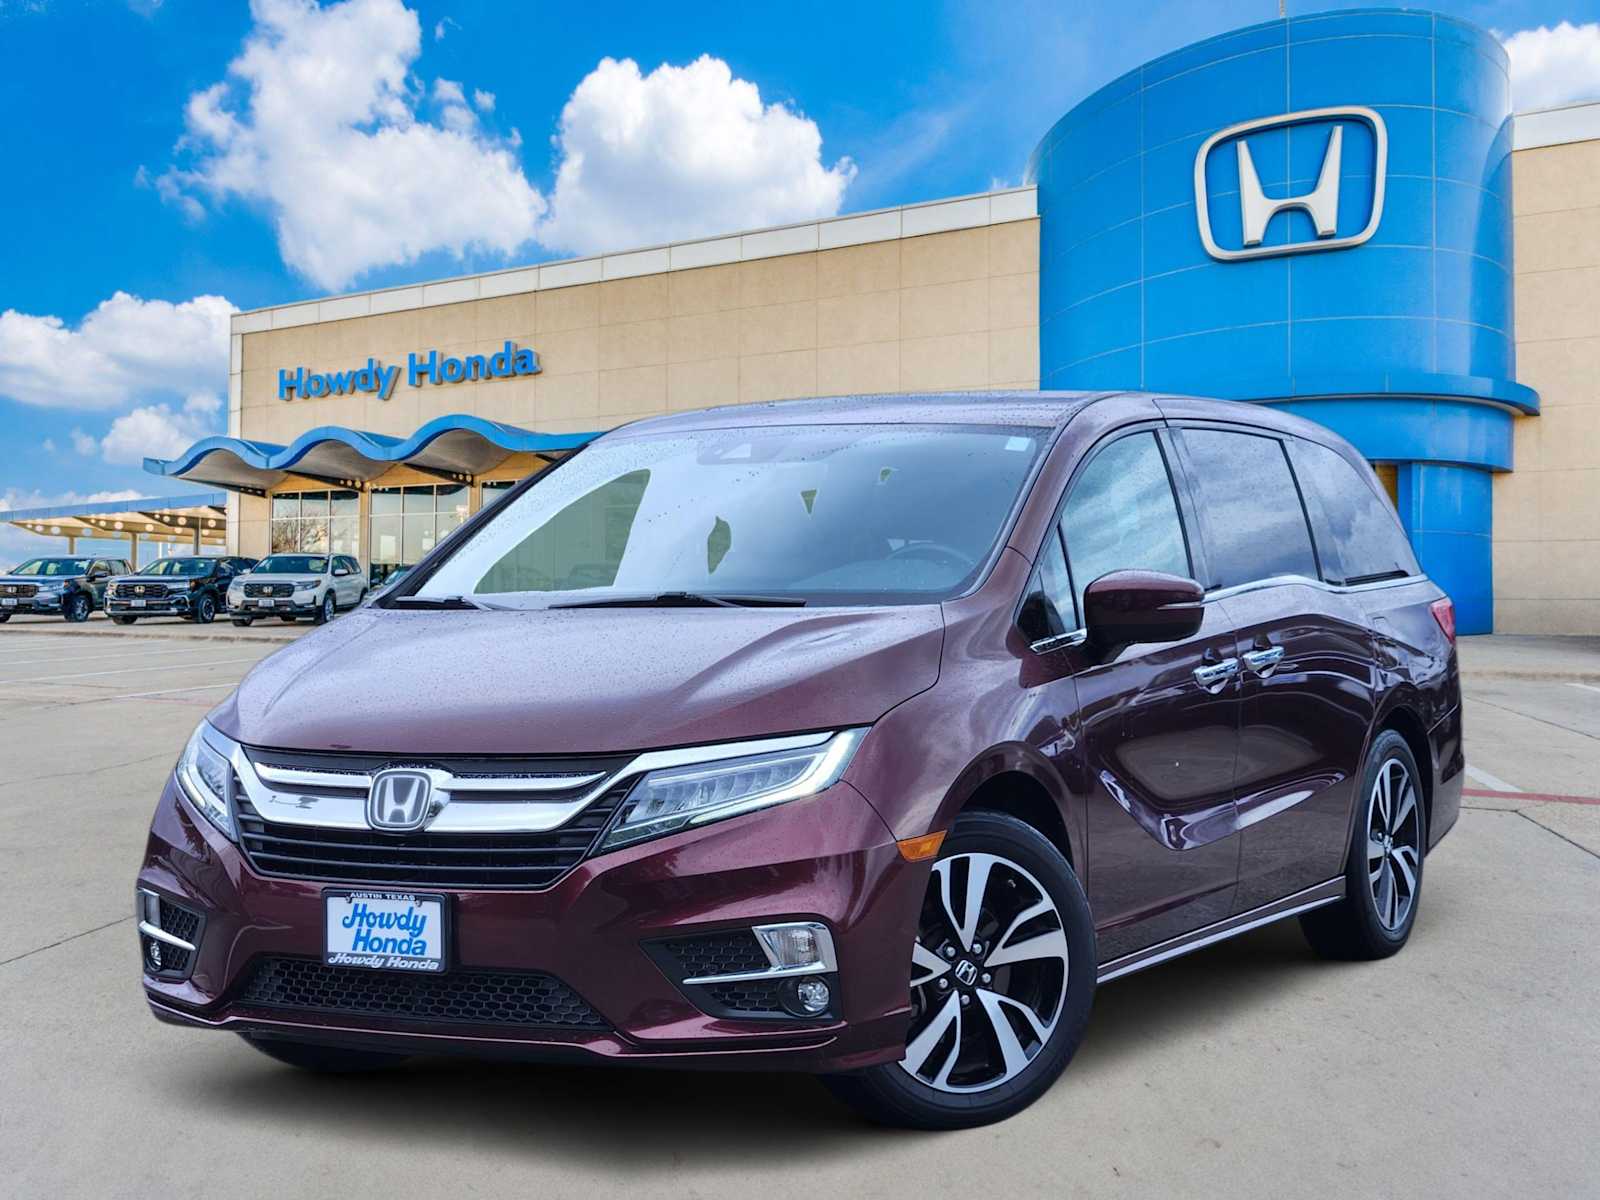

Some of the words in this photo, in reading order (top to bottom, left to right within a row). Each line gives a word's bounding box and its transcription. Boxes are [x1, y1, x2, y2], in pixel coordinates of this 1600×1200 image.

[278, 358, 400, 400] Howdy
[408, 340, 541, 387] Honda
[342, 903, 427, 937] Howdy
[352, 928, 427, 956] Honda
[328, 953, 385, 968] Howdy
[386, 956, 439, 970] Honda
